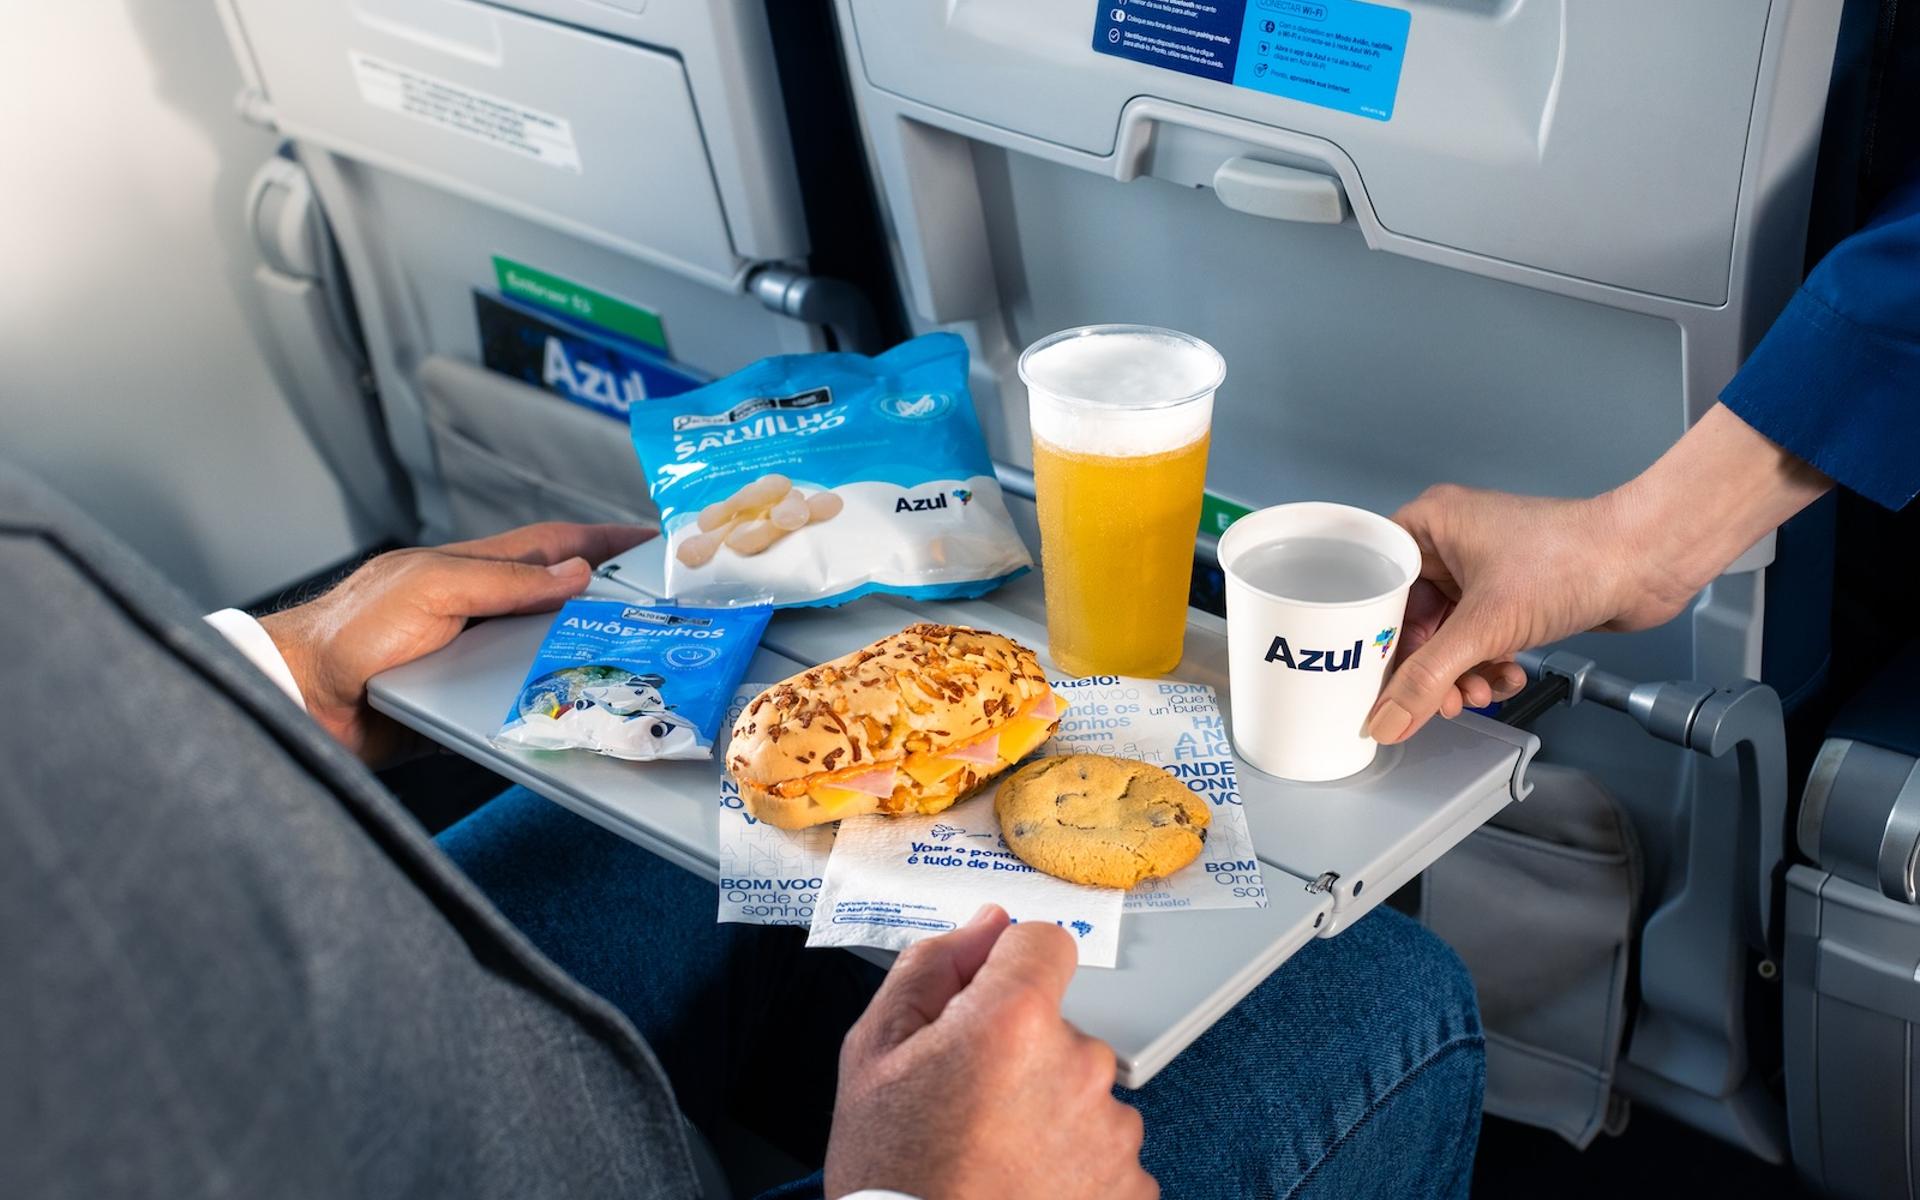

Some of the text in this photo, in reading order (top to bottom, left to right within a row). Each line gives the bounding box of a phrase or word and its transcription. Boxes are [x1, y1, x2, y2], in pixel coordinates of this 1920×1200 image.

[543, 335, 647, 412] Azul
[895, 493, 947, 514] Azul
[563, 617, 725, 639] AVIÕEZINHOS
[1264, 636, 1363, 672] Azul
[1049, 676, 1120, 688] vuelo!
[1158, 684, 1208, 694] BOM
[1115, 703, 1140, 714] os
[1149, 703, 1214, 716] un buen
[1054, 732, 1114, 742] voam
[911, 842, 952, 854] Voar
[908, 854, 919, 864] é
[923, 856, 962, 867] tudo
[967, 858, 988, 869] de
[1205, 860, 1256, 872] BOM
[720, 879, 772, 890] BOM
[727, 890, 791, 904] Onde
[741, 904, 814, 917] sonho
